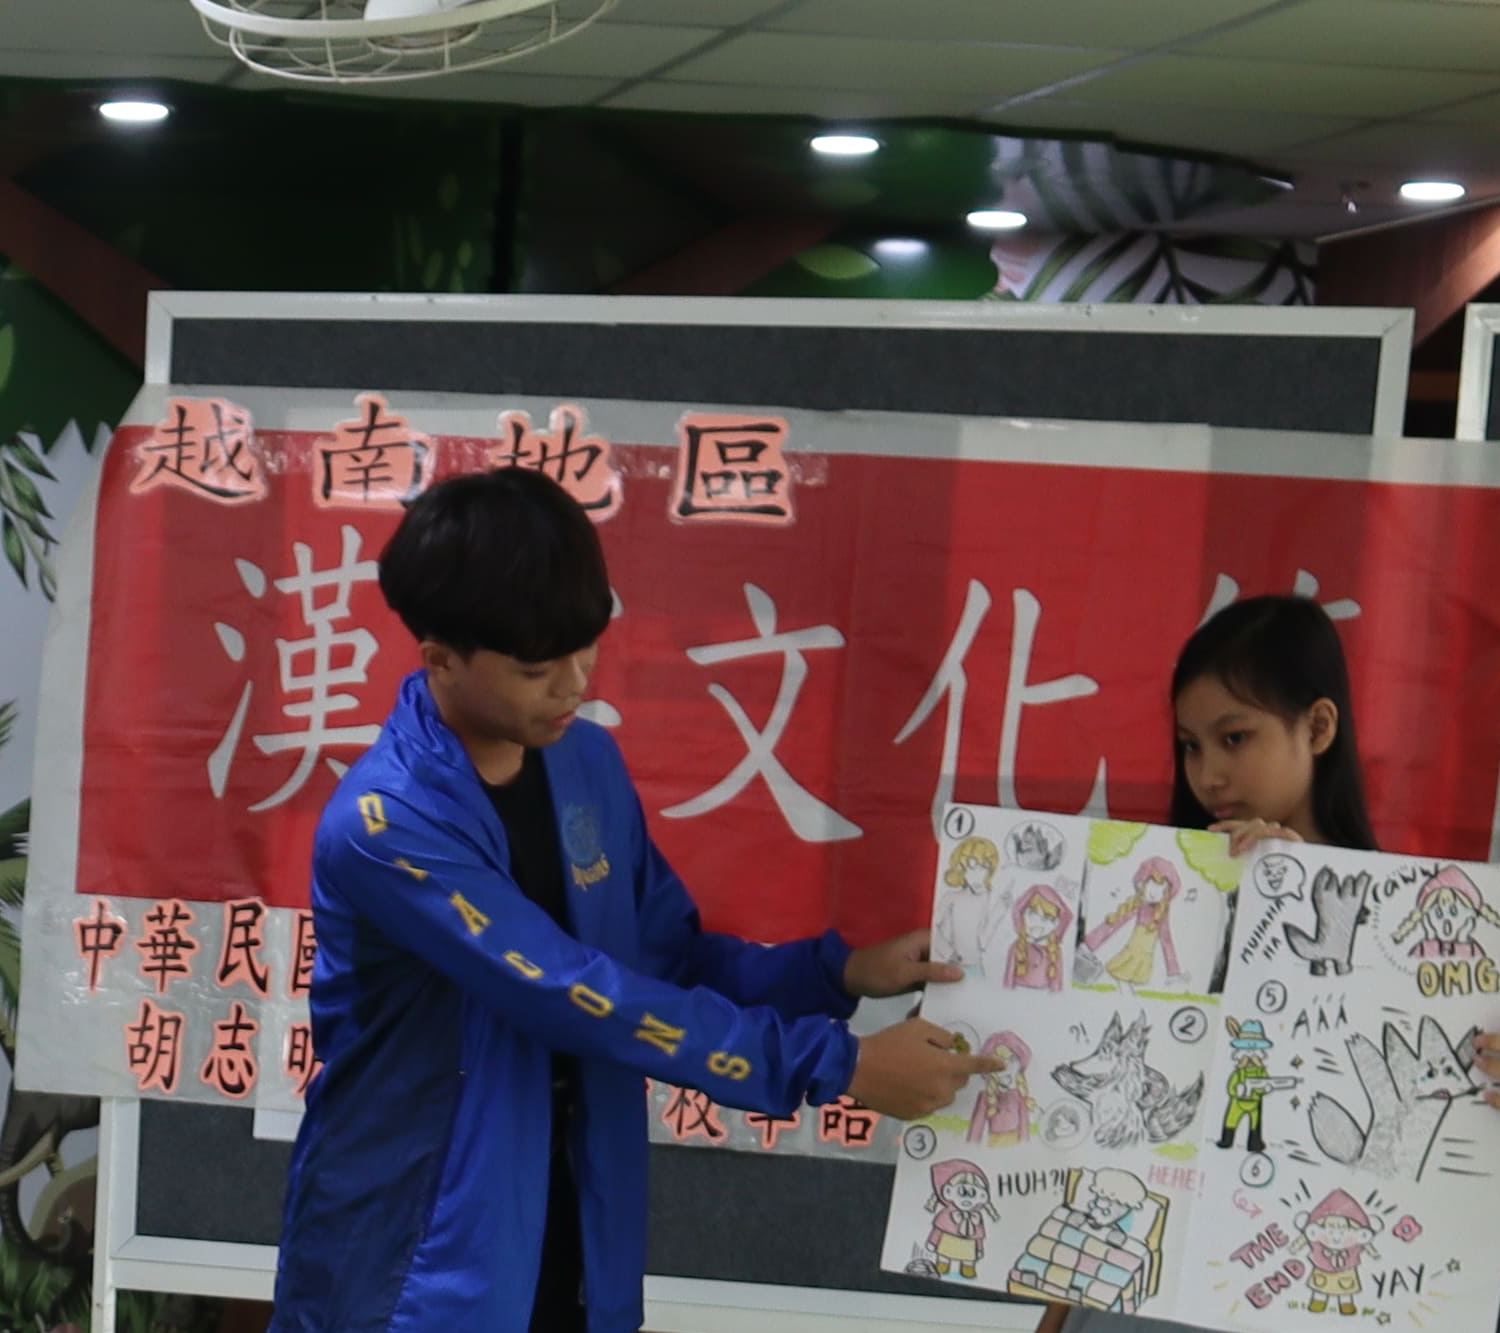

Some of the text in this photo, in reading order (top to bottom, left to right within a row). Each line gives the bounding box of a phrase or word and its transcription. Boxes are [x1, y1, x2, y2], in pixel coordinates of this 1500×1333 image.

[130, 402, 797, 520] 越南地區
[208, 525, 1362, 856] 漢文化
[998, 1168, 1067, 1198] HUH?!
[1150, 1164, 1206, 1198] HEHE!
[1229, 1222, 1291, 1269] THE
[1245, 1258, 1307, 1310] END
[1371, 1263, 1426, 1300] YAY
